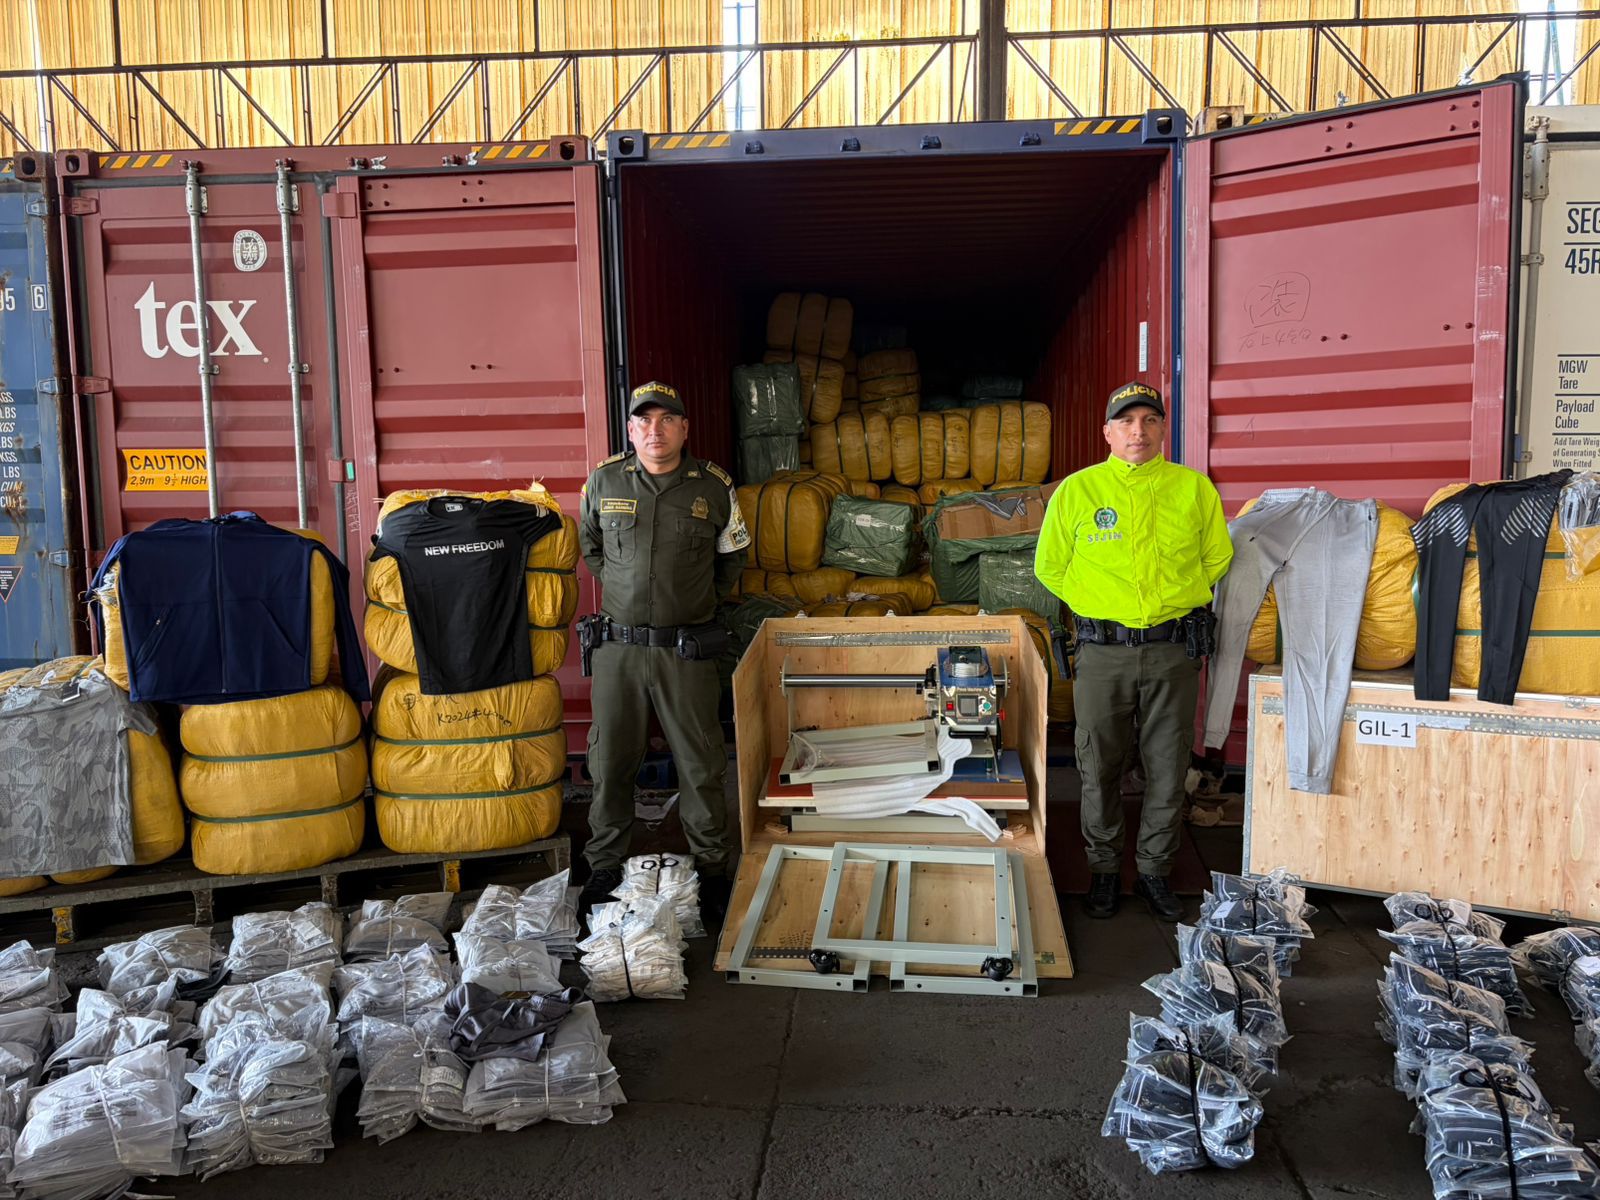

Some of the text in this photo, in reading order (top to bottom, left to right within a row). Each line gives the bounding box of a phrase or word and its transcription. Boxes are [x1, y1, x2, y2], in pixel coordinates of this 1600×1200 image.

[33, 286, 45, 309] 6
[1558, 359, 1588, 373] MGW
[1558, 376, 1579, 389] Tare
[634, 384, 676, 399] POLICIA
[1556, 399, 1595, 415] Payload
[1555, 416, 1579, 429] Cube
[1554, 437, 1567, 446] Add
[1569, 437, 1582, 446] Tare
[1553, 448, 1560, 457] of
[1561, 448, 1597, 458] Generating
[130, 455, 207, 471] CAUTION
[1552, 459, 1592, 468] When Fitted
[3, 466, 20, 479] LBS
[180, 475, 207, 486] HIGH
[424, 539, 505, 557] NEW FREEDOM
[1358, 719, 1411, 738] GIL-1
